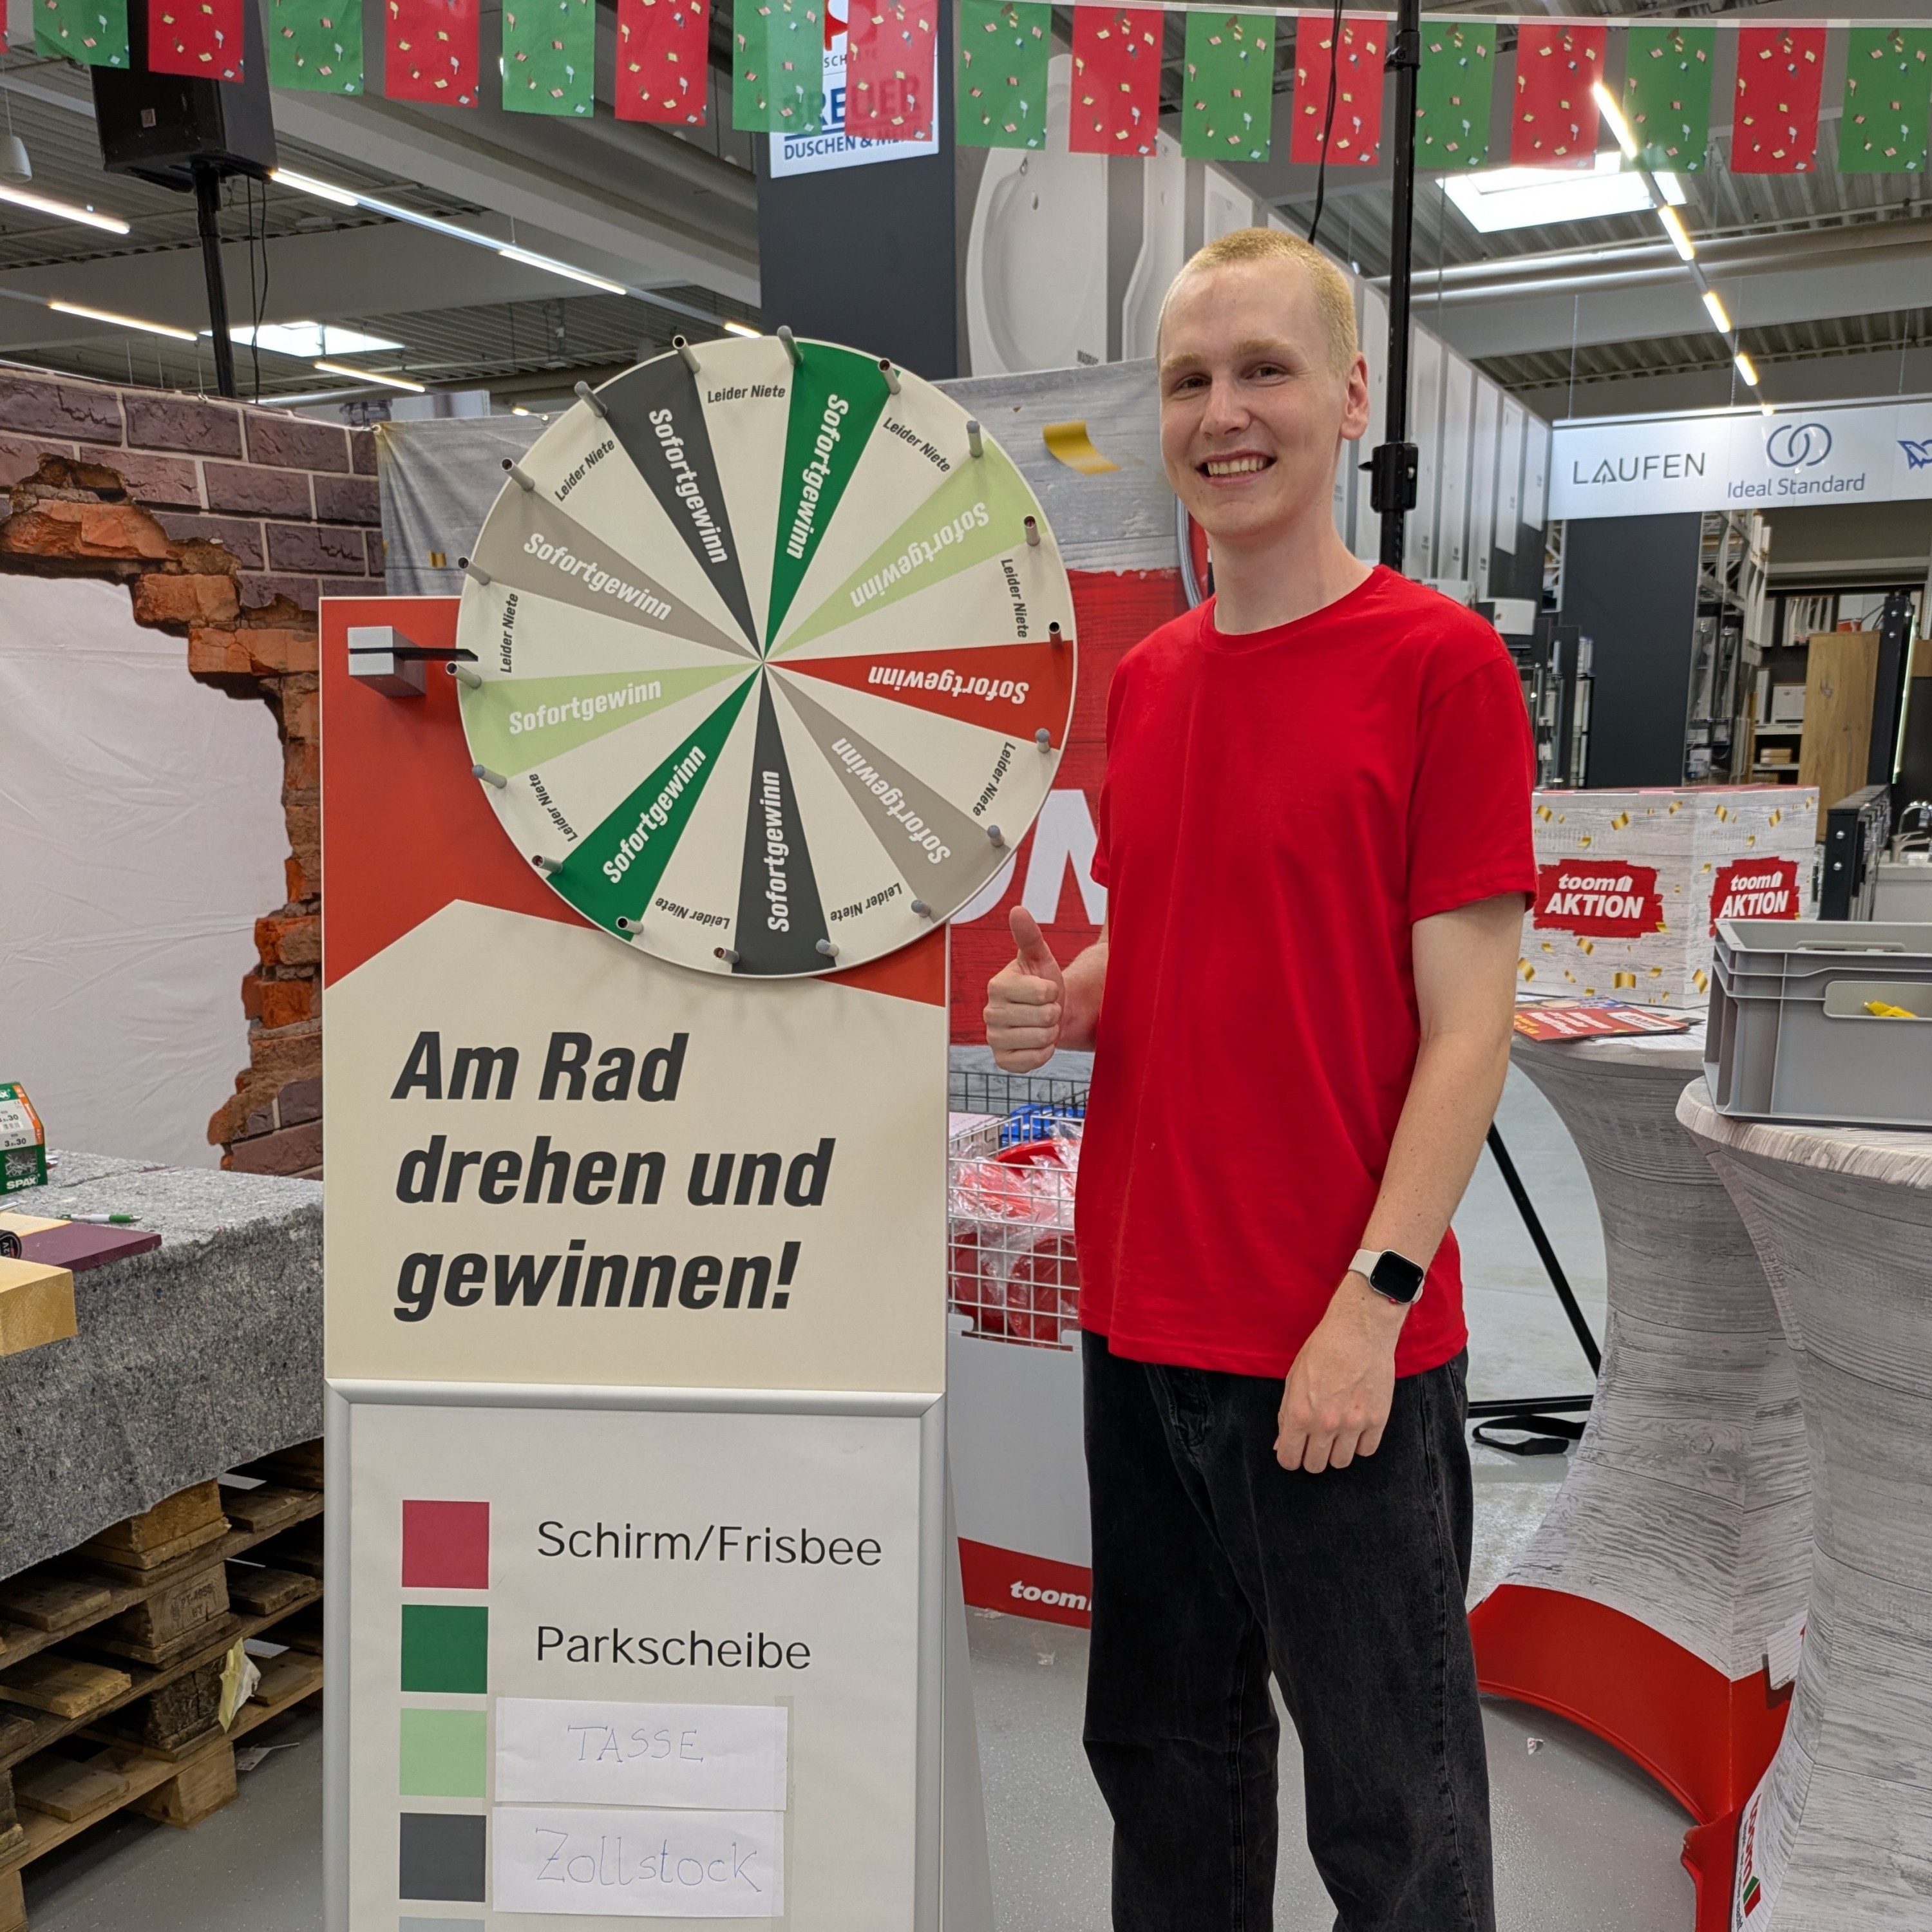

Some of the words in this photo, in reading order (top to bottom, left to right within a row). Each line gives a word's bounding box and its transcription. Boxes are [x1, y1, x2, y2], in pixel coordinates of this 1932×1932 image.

[784, 135, 856, 160] DUSCHEN
[708, 386, 748, 404] Leider
[751, 384, 786, 398] Niete
[883, 417, 922, 446] Leider
[919, 442, 951, 472] Niete
[554, 464, 586, 502] Leider
[584, 440, 615, 469] Niete
[649, 408, 728, 564] Sofortgewinn
[786, 393, 849, 559] Sofortgewinn
[1573, 452, 1705, 485] LAUFEN
[1727, 478, 1772, 498] Ideal
[1777, 473, 1865, 496] Standard
[849, 502, 989, 607] Sofortgewinn
[524, 533, 672, 621] Sofortgewinn
[502, 593, 518, 629] Niete
[1000, 558, 1021, 600] Leider
[1013, 603, 1029, 638] Niete
[500, 630, 513, 674] Leider
[868, 667, 1029, 705] Sofortgewinn
[509, 681, 661, 735] Sofortgewinn
[992, 742, 1016, 784] Leider
[529, 773, 553, 806] Niete
[831, 738, 951, 864] Sofortgewinn
[972, 782, 998, 816] Niete
[547, 808, 578, 842] Leider
[603, 745, 706, 884] Sofortgewinn
[759, 771, 790, 932] Sofortgewinn
[865, 882, 902, 909] Leider
[1558, 873, 1615, 891] toom
[1730, 874, 1771, 892] toom
[655, 898, 690, 919] Niete
[689, 911, 730, 929] Leider
[830, 902, 863, 922] Niete
[1544, 893, 1644, 919] AKTION
[1719, 890, 1789, 918] AKTION
[390, 1030, 520, 1101] Am
[538, 1031, 689, 1103] Rad
[6, 1174, 39, 1189] SPAX
[395, 1134, 666, 1205] drehen
[687, 1137, 836, 1208] und
[393, 1239, 802, 1322] gewinnen!
[536, 1520, 882, 1566] Schirm/Frisbee
[1010, 1580, 1087, 1611] toom
[537, 1625, 811, 1669] Parkscheibe
[567, 1724, 704, 1763] TASSE
[535, 1827, 762, 1893] Zollstock
